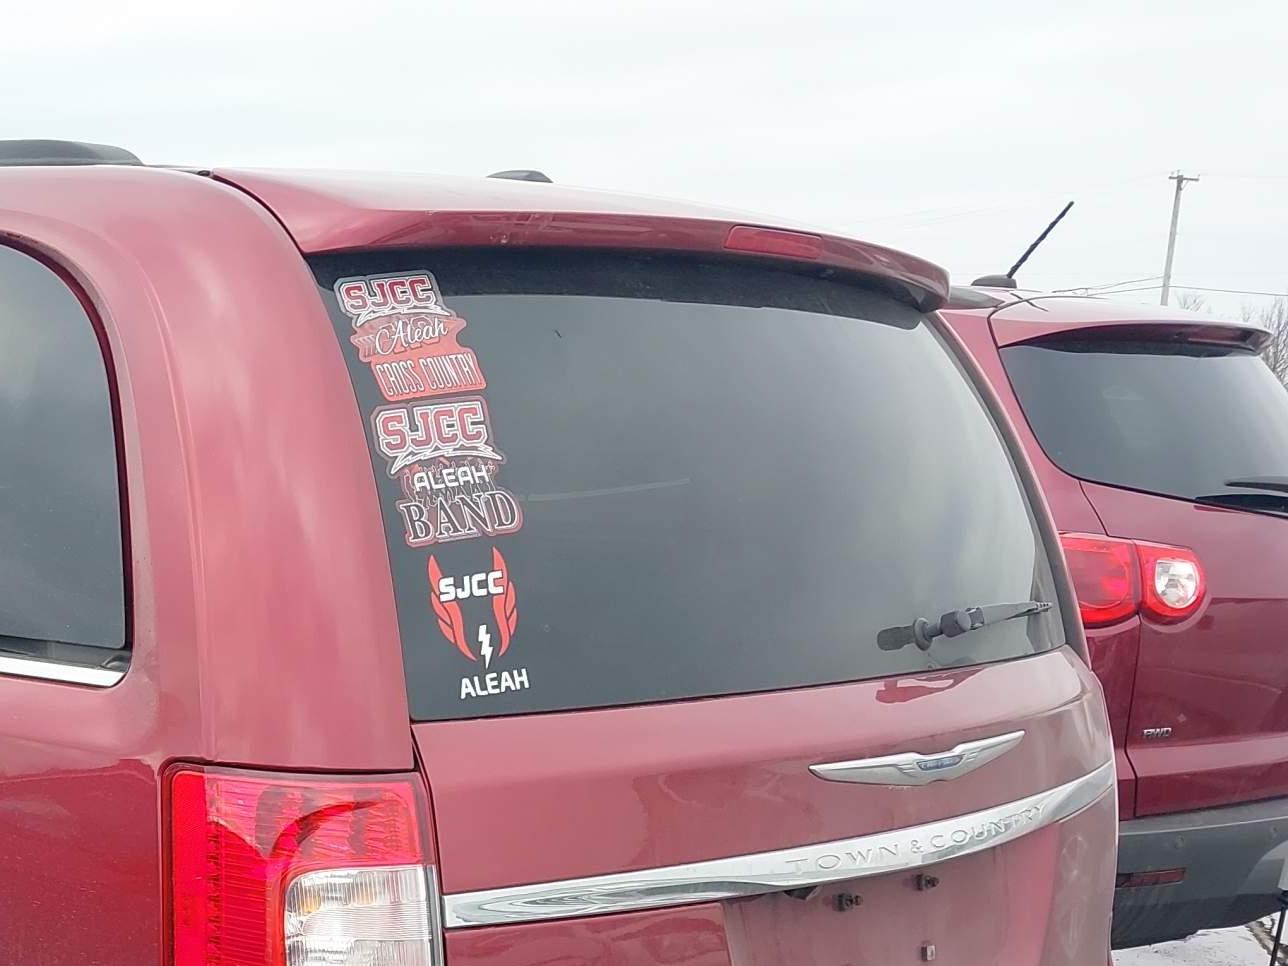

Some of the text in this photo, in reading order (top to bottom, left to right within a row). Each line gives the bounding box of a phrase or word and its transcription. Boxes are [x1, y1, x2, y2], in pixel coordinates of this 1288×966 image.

[340, 275, 436, 315] SJCC
[375, 318, 448, 355] Aleah
[375, 352, 482, 397] CROSS COUNTRY
[375, 401, 488, 457] SJCC
[413, 465, 490, 491] ALEAH
[399, 490, 520, 543] BAND
[439, 570, 504, 602] SJCC
[460, 667, 530, 700] ALEAH
[786, 803, 1047, 874] TOWN & COUNTRY
